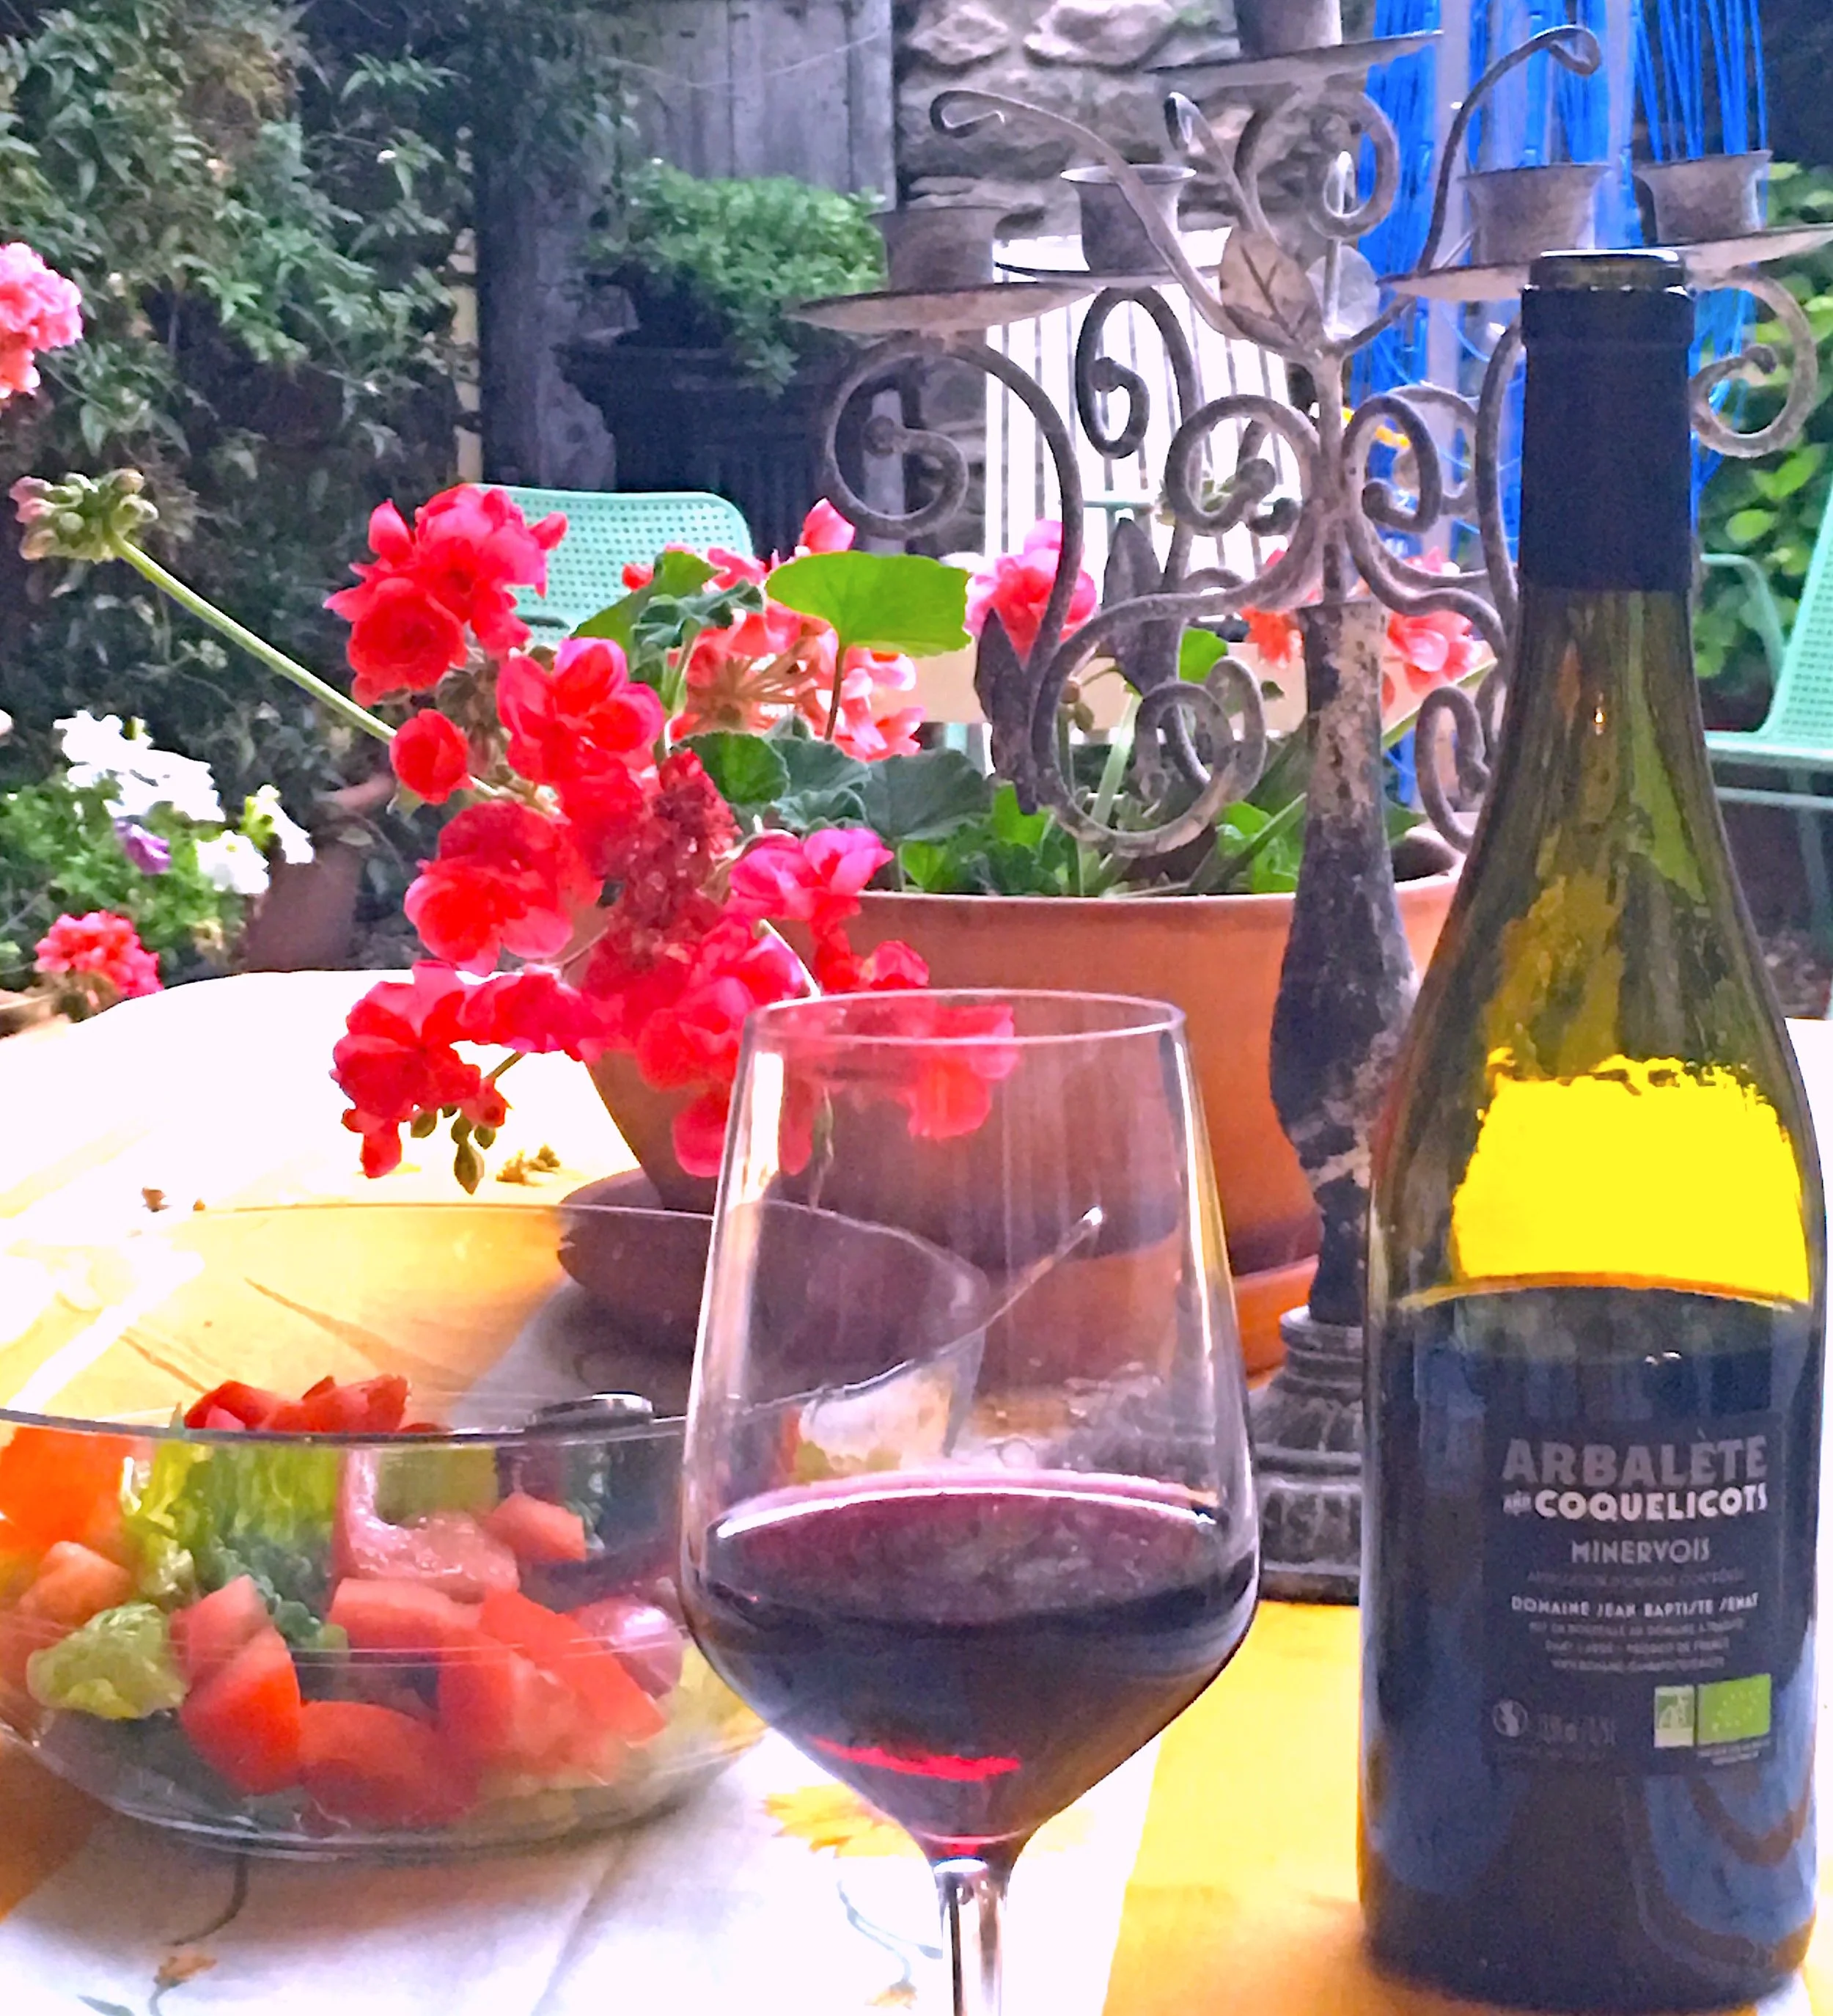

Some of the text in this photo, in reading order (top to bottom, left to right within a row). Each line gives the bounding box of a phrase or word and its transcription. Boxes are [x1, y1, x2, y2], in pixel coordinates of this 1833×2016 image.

[1502, 1429, 1768, 1488] ARBALÈTE
[1535, 1482, 1768, 1522] COQUELICOTS
[1572, 1537, 1710, 1564] MINERVOIS
[1511, 1596, 1590, 1616] DOMAINE
[1596, 1602, 1636, 1619] JEAN
[1644, 1599, 1713, 1618] BAPTISTE
